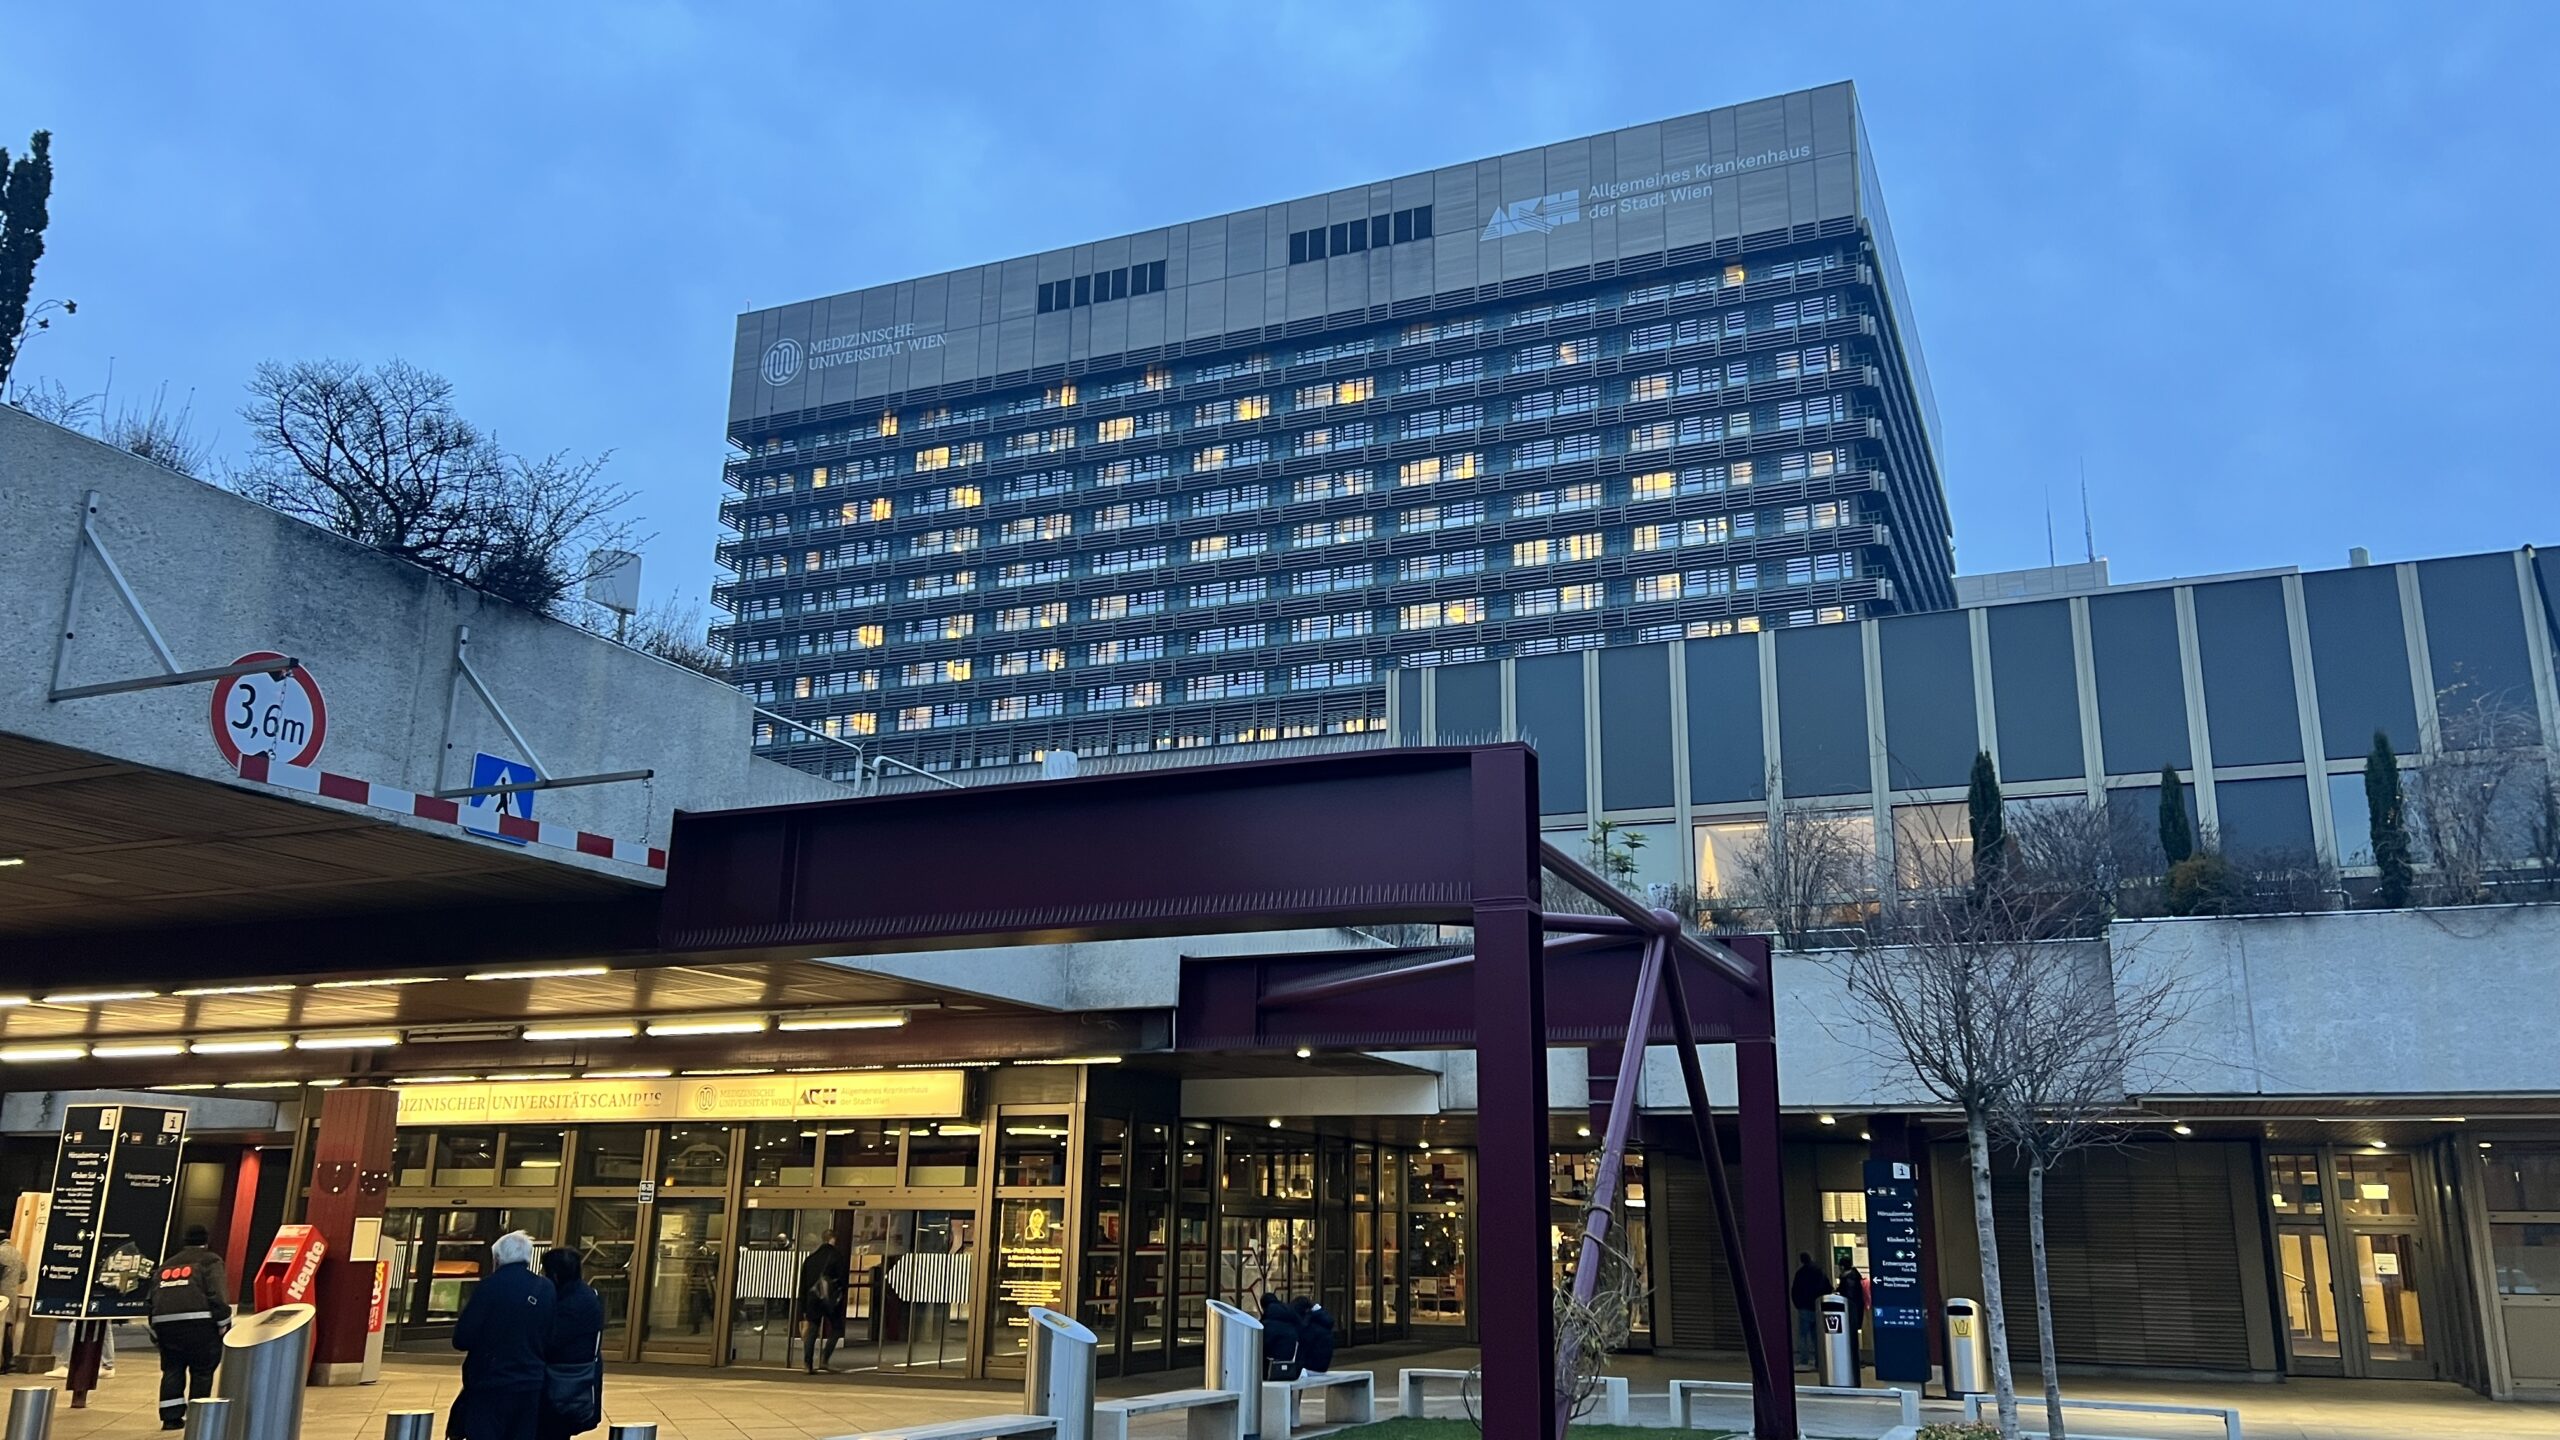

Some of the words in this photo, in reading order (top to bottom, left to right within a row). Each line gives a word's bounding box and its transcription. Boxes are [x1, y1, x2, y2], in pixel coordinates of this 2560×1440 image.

[1588, 169, 1691, 200] Allgemeines
[1695, 145, 1811, 179] Krankenhaus
[1588, 202, 1616, 220] der
[1620, 192, 1668, 214] Stadt
[1671, 184, 1713, 203] Wien
[808, 340, 903, 371] UNIVERSITÄT
[907, 333, 948, 351] WIEN
[809, 323, 915, 355] MEDIZINISCHE
[492, 1091, 662, 1111] UNIVERSITÄTSCAMPUS
[719, 1088, 776, 1098] MEDIZINISCHE
[771, 1097, 793, 1107] WIEN
[841, 1087, 882, 1097] Allgemeines
[883, 1086, 929, 1095] Krankenhaus
[286, 1241, 325, 1301] Heute
